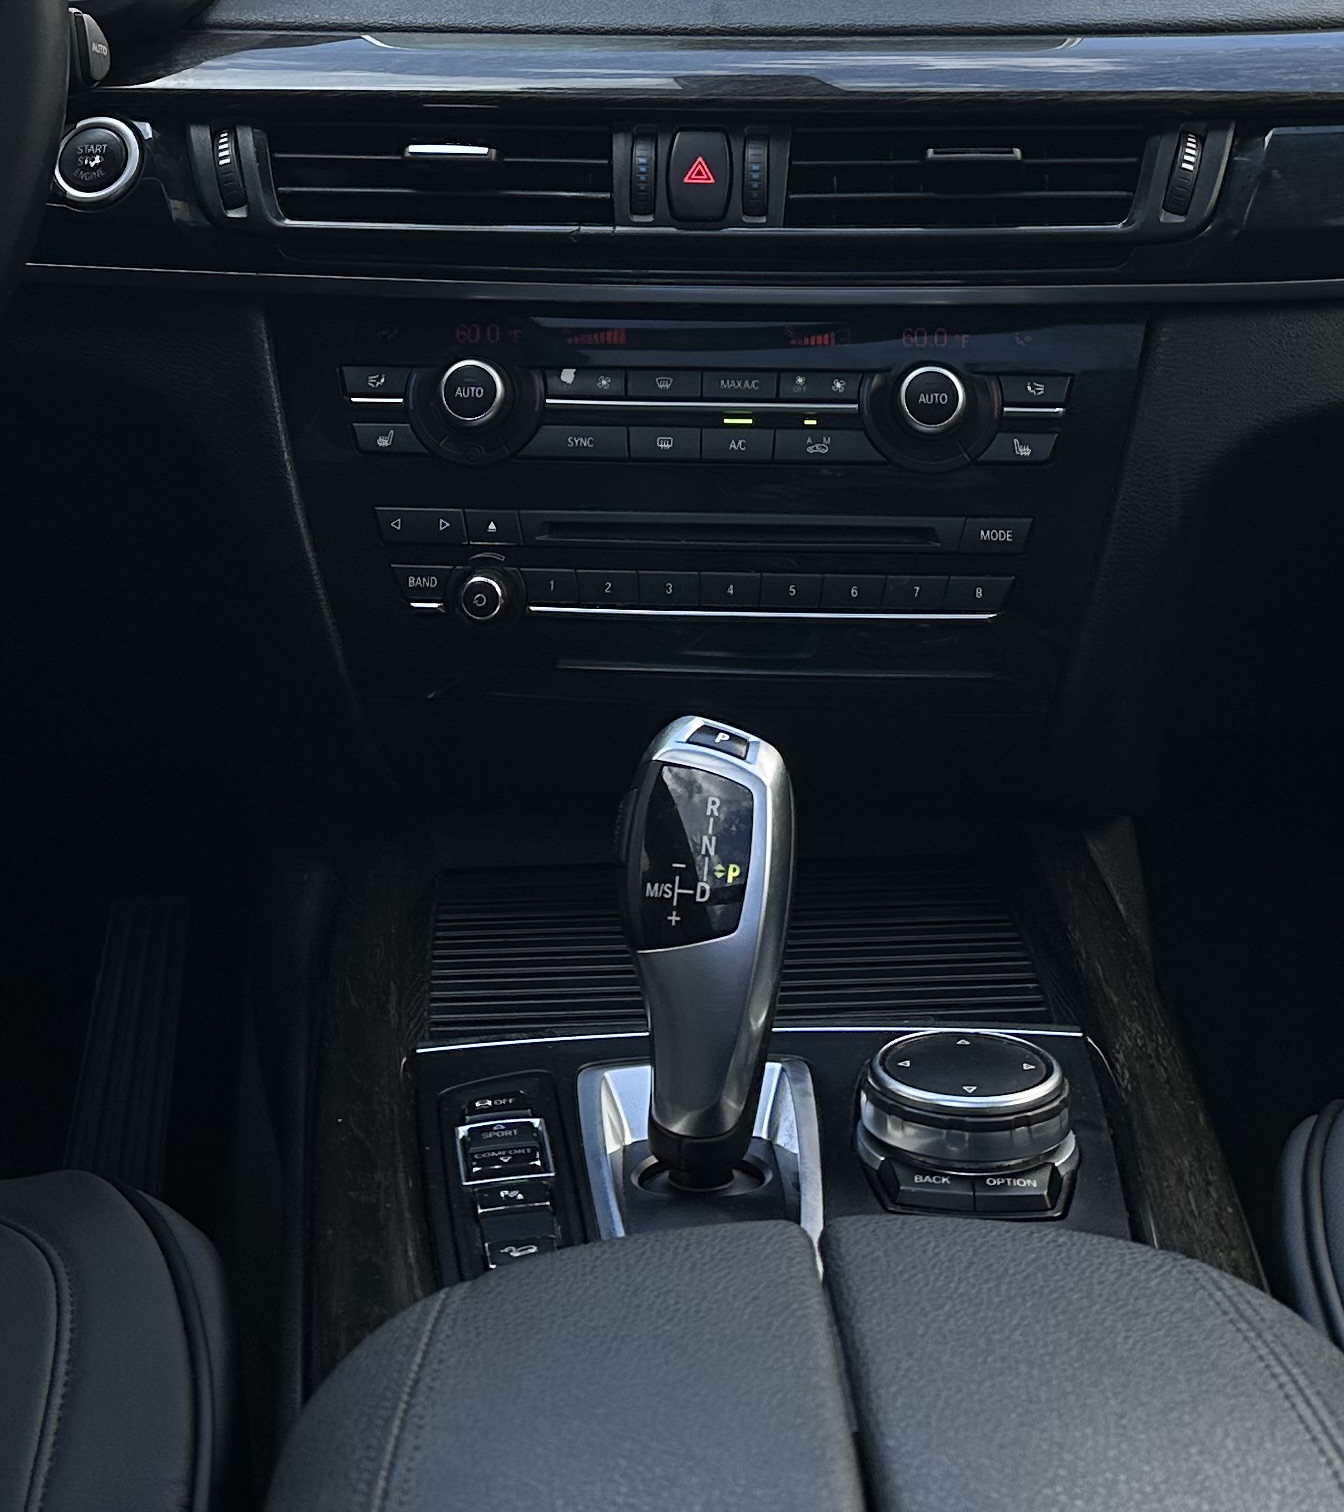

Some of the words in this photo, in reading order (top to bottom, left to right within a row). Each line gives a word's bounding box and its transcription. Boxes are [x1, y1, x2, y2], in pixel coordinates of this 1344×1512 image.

[76, 143, 108, 155] START
[720, 379, 743, 390] MAX
[743, 379, 760, 390] A/C
[455, 386, 485, 399] AUTO
[918, 393, 949, 405] AUTO
[567, 437, 595, 448] SYNC
[728, 439, 747, 451] A/C
[979, 529, 1013, 542] MODE
[407, 575, 438, 589] BAND
[548, 580, 555, 592] 1
[604, 582, 612, 595] 2
[665, 583, 673, 595] 3
[726, 584, 734, 596] 4
[788, 585, 796, 597] 5
[850, 585, 859, 598] 6
[913, 586, 921, 598] 7
[975, 587, 984, 599] 8
[714, 732, 731, 743] P
[706, 796, 721, 817] R
[700, 835, 717, 856] N
[726, 863, 741, 884] P
[645, 882, 673, 899] M/S
[695, 881, 711, 903] D
[481, 1128, 519, 1139] SPORT
[473, 1147, 531, 1159] COMFORT
[913, 1174, 951, 1184] BACK
[985, 1176, 1037, 1188] OPTION
